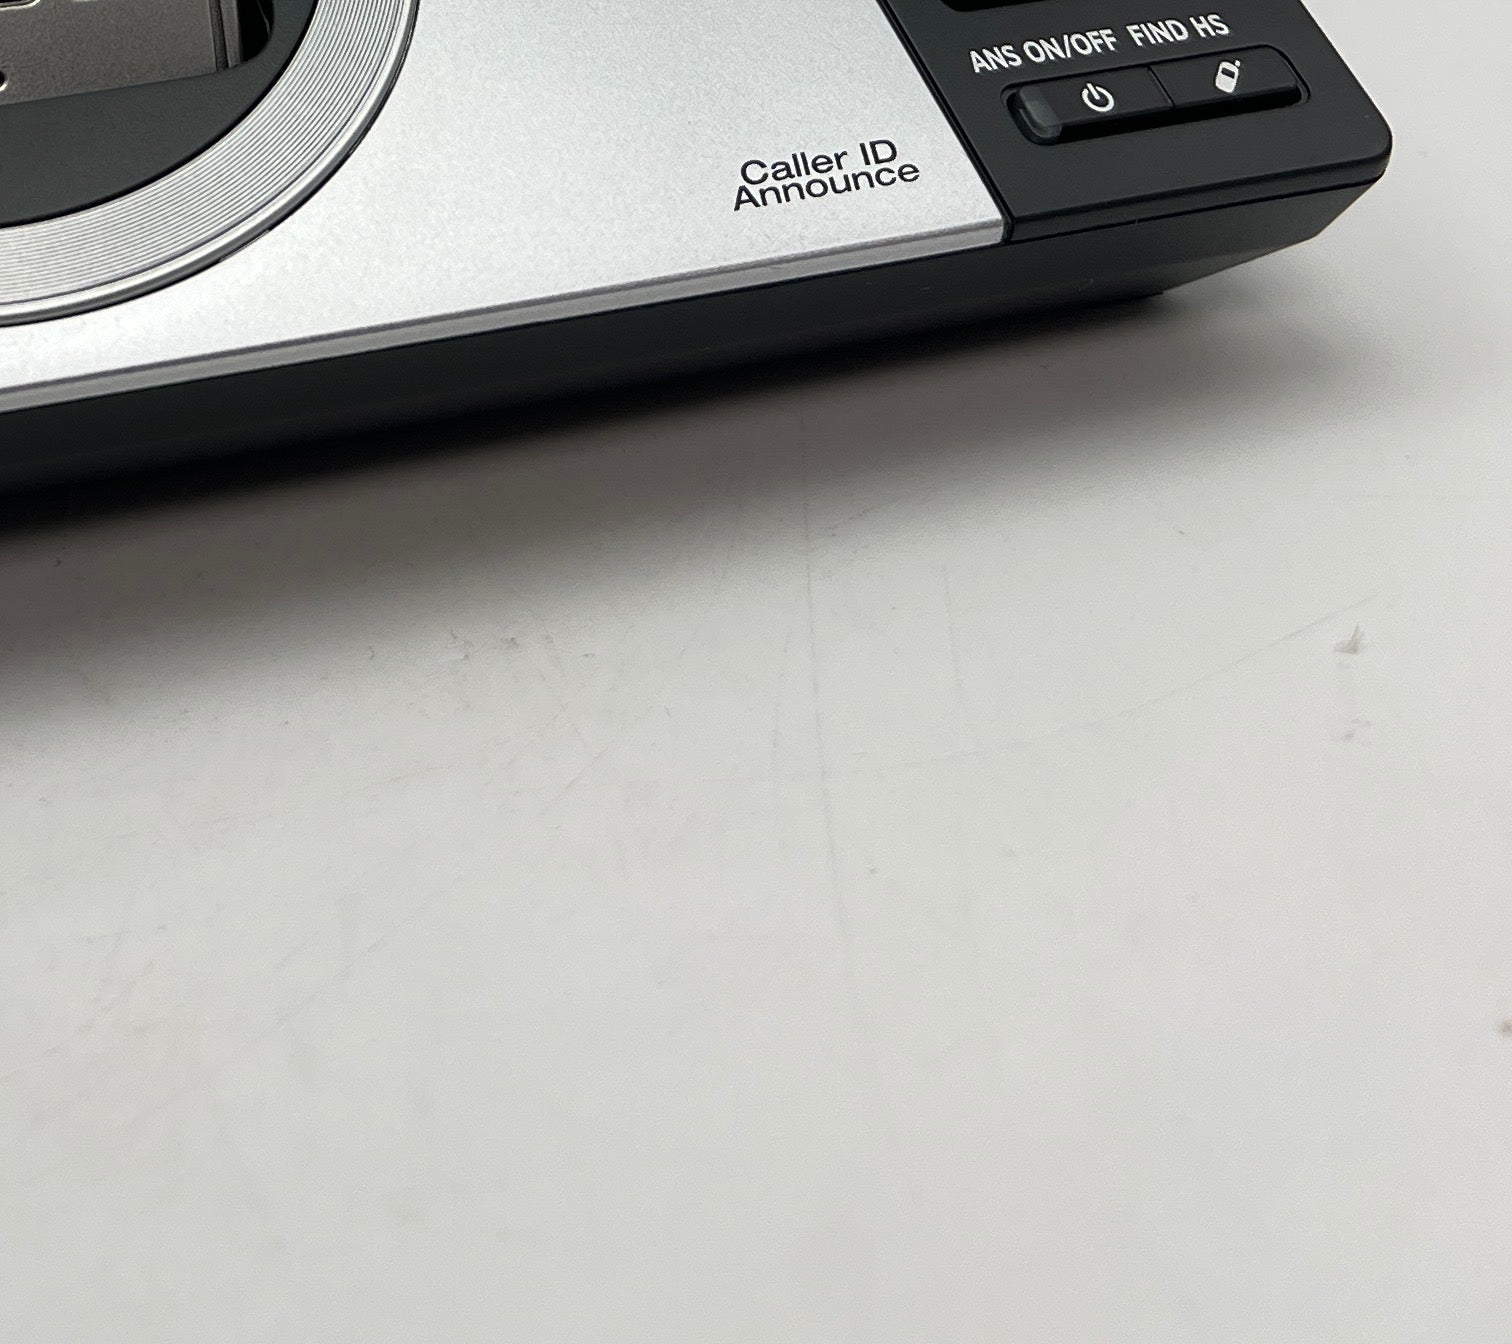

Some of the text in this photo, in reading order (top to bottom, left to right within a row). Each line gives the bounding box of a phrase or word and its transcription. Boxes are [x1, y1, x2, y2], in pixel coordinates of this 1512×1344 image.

[968, 28, 1118, 74] ANS ON/OFF
[1125, 14, 1231, 47] FIND HS
[738, 138, 899, 186] Caller ID
[732, 160, 921, 212] Announce
